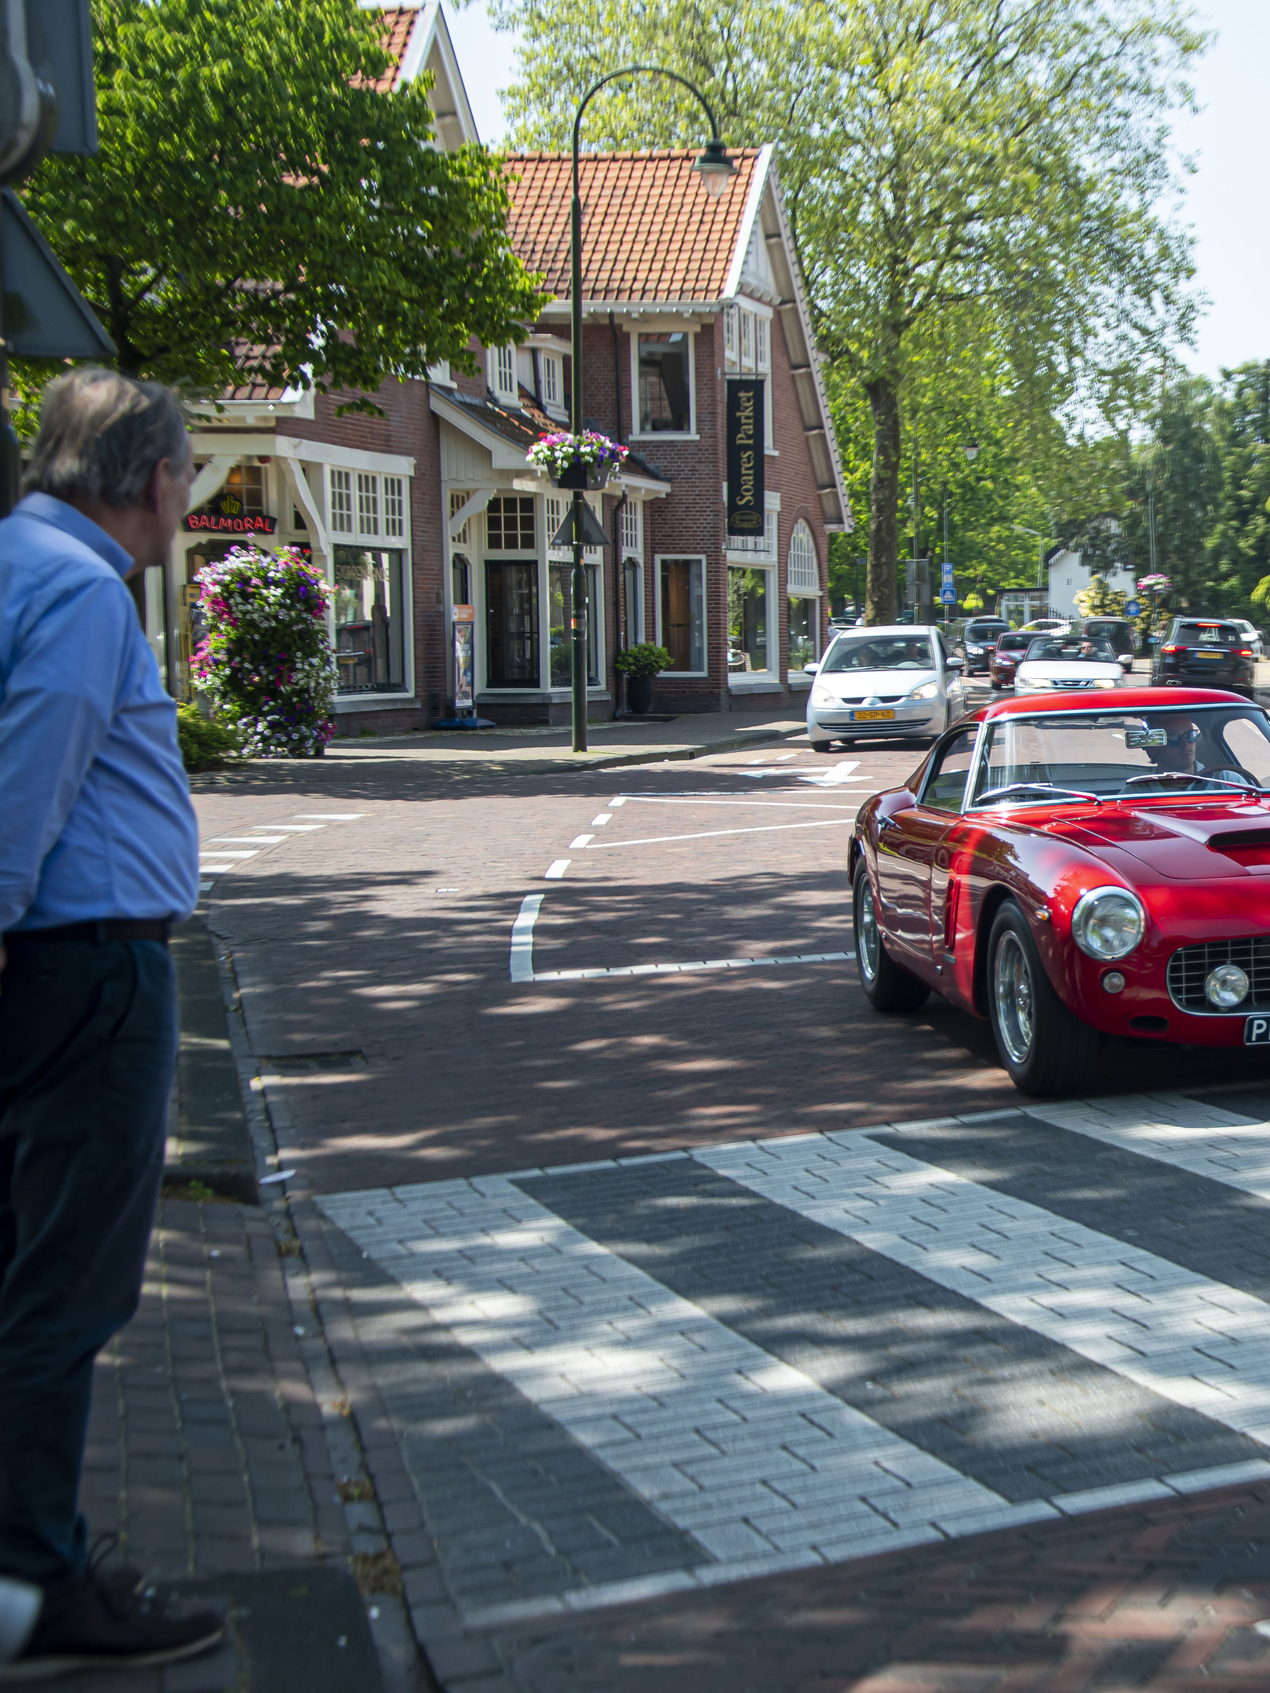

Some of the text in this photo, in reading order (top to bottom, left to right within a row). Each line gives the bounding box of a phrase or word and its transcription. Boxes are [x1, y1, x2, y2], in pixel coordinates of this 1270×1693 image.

[735, 390, 755, 446] Parket
[736, 451, 755, 506] Soares
[188, 514, 274, 532] BALMORAL
